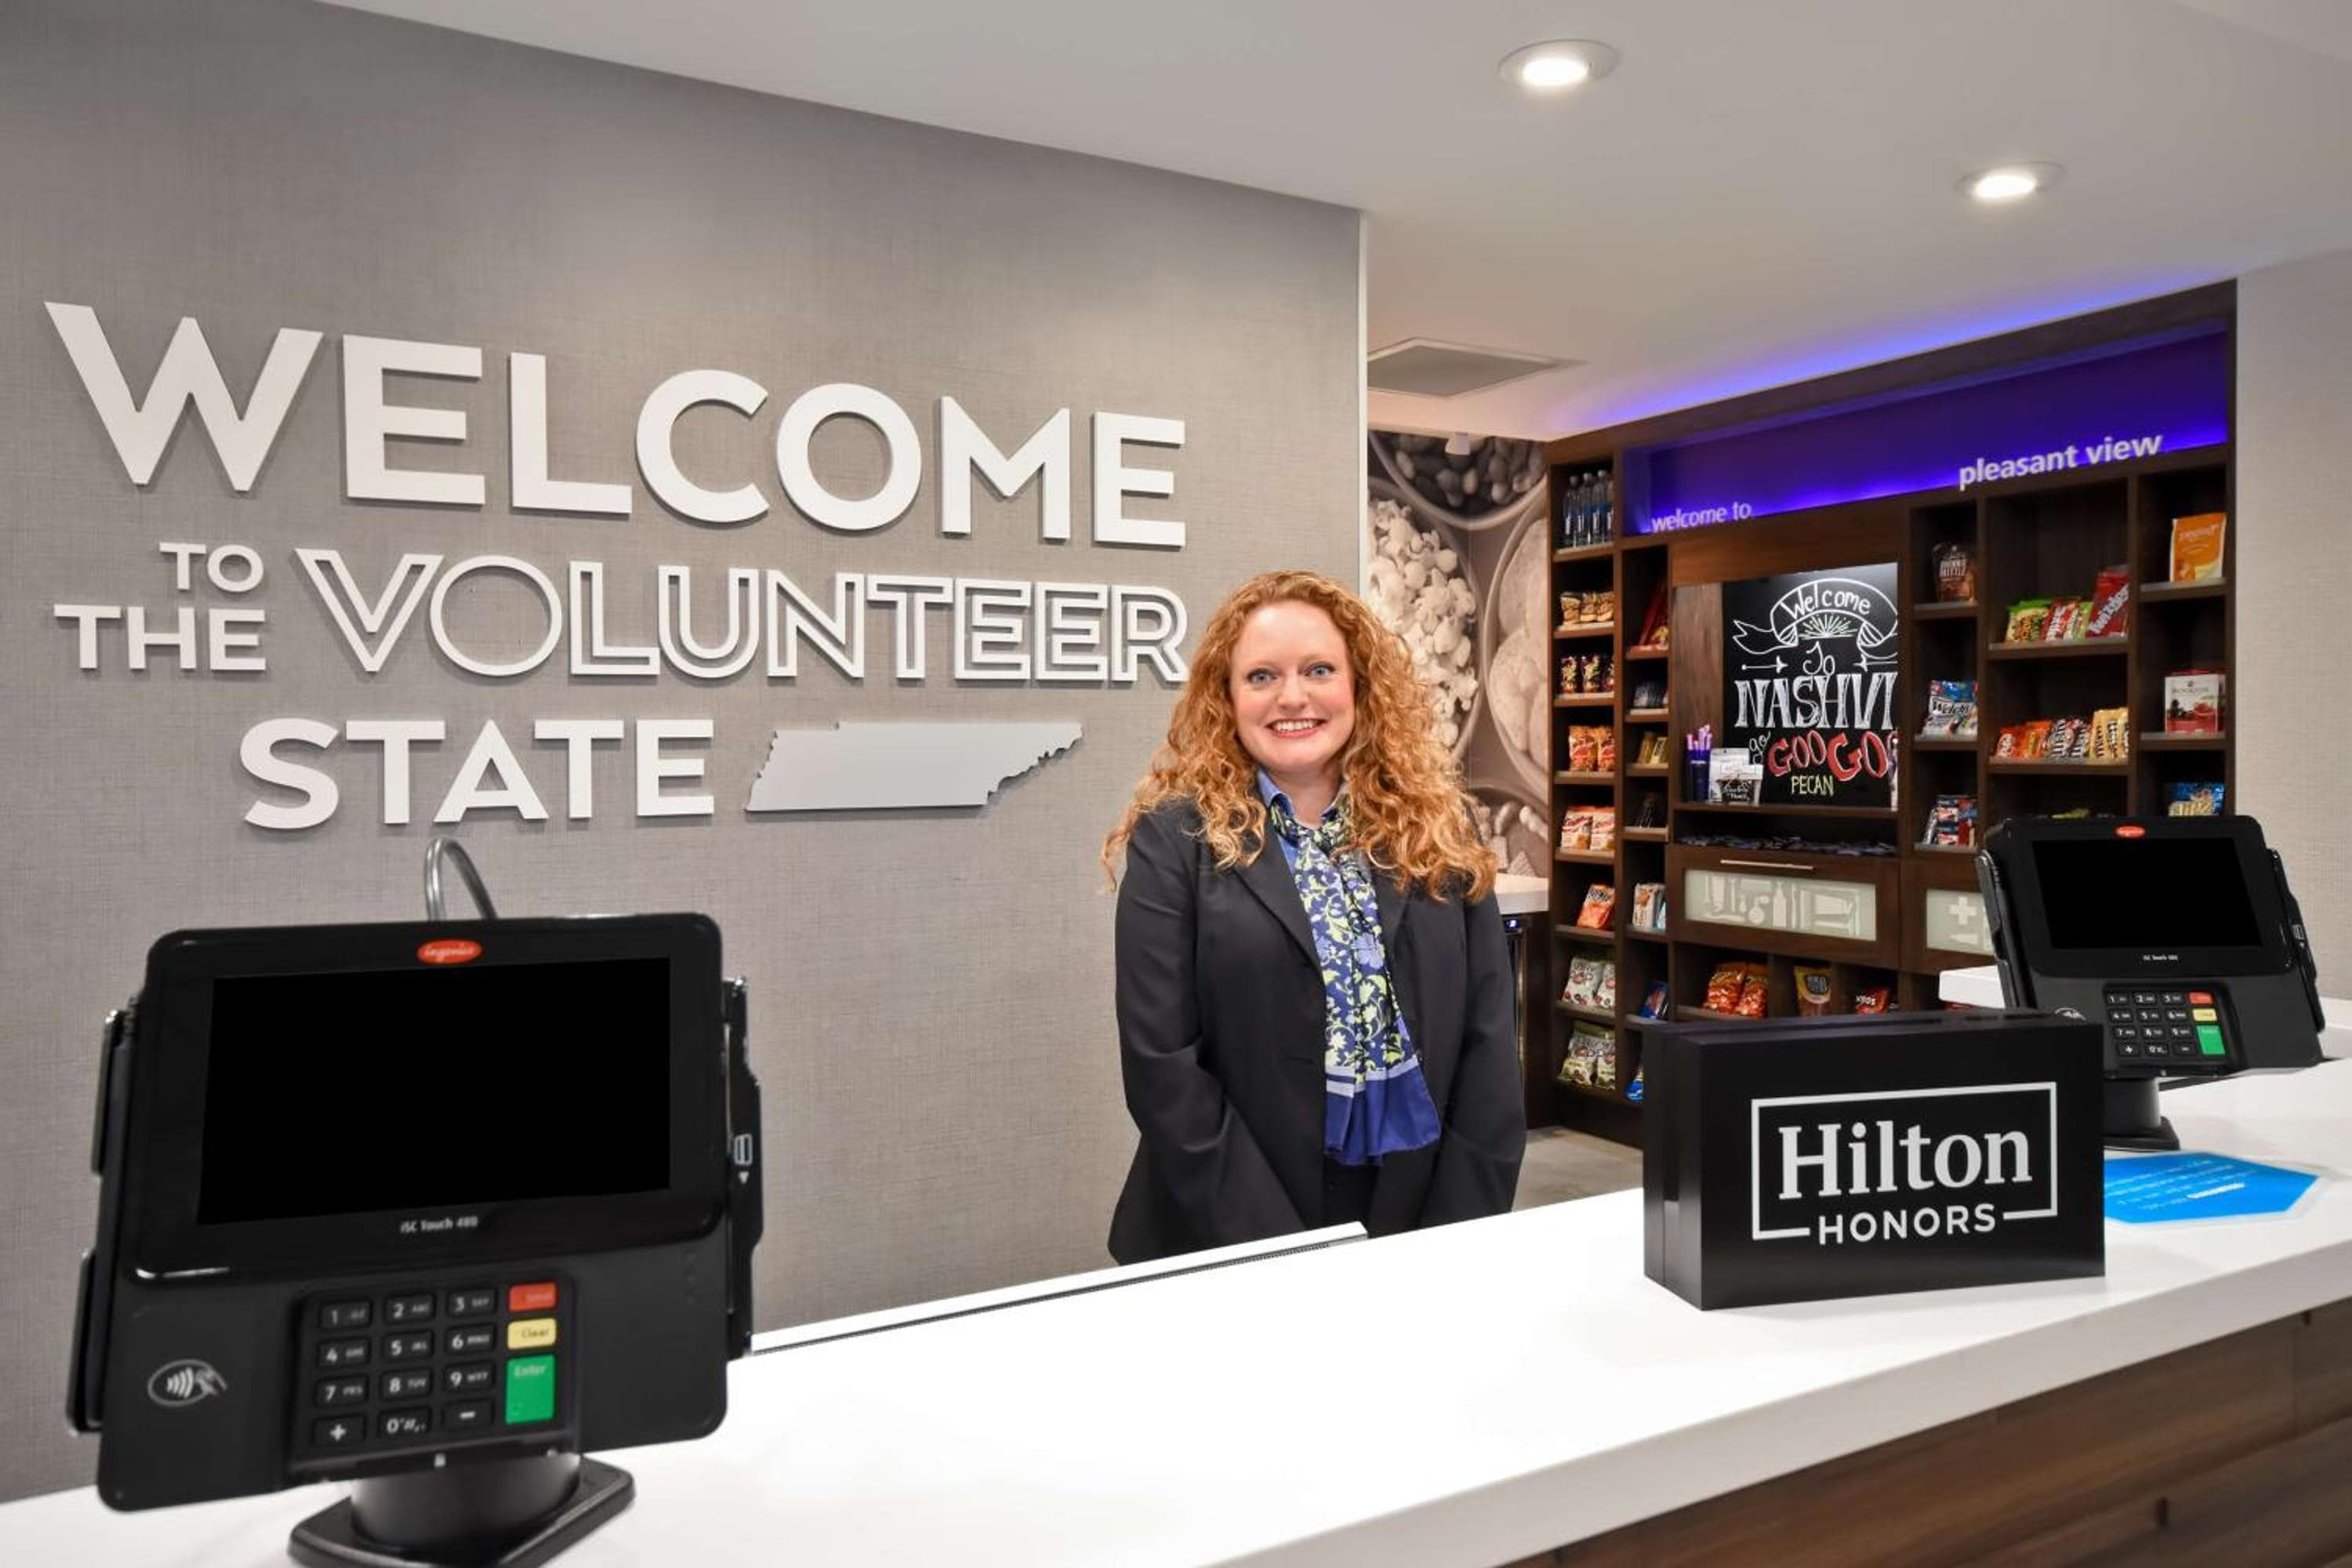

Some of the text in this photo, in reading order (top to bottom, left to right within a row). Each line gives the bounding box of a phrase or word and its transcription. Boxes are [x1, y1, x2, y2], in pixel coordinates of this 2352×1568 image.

[44, 302, 1185, 547] WELCOME
[1959, 435, 2162, 492] pleasant view
[1651, 502, 1752, 533] welcome to
[159, 542, 264, 593] TO
[53, 547, 1189, 682] THE VOLUNTEER
[1780, 583, 1871, 619] Welcome
[1733, 672, 1898, 729] NASHVI
[240, 718, 714, 829] STATE
[1791, 775, 1835, 796] PECAN
[1778, 1120, 2033, 1200] Hilton
[1819, 1203, 1995, 1245] HONORS
[394, 1302, 404, 1318] 2
[455, 1295, 465, 1312] 3
[326, 1348, 338, 1363] 4
[391, 1339, 402, 1356] 5
[452, 1334, 463, 1348] 6
[326, 1385, 336, 1402] 7
[390, 1377, 401, 1393] 8
[450, 1371, 463, 1387] 9
